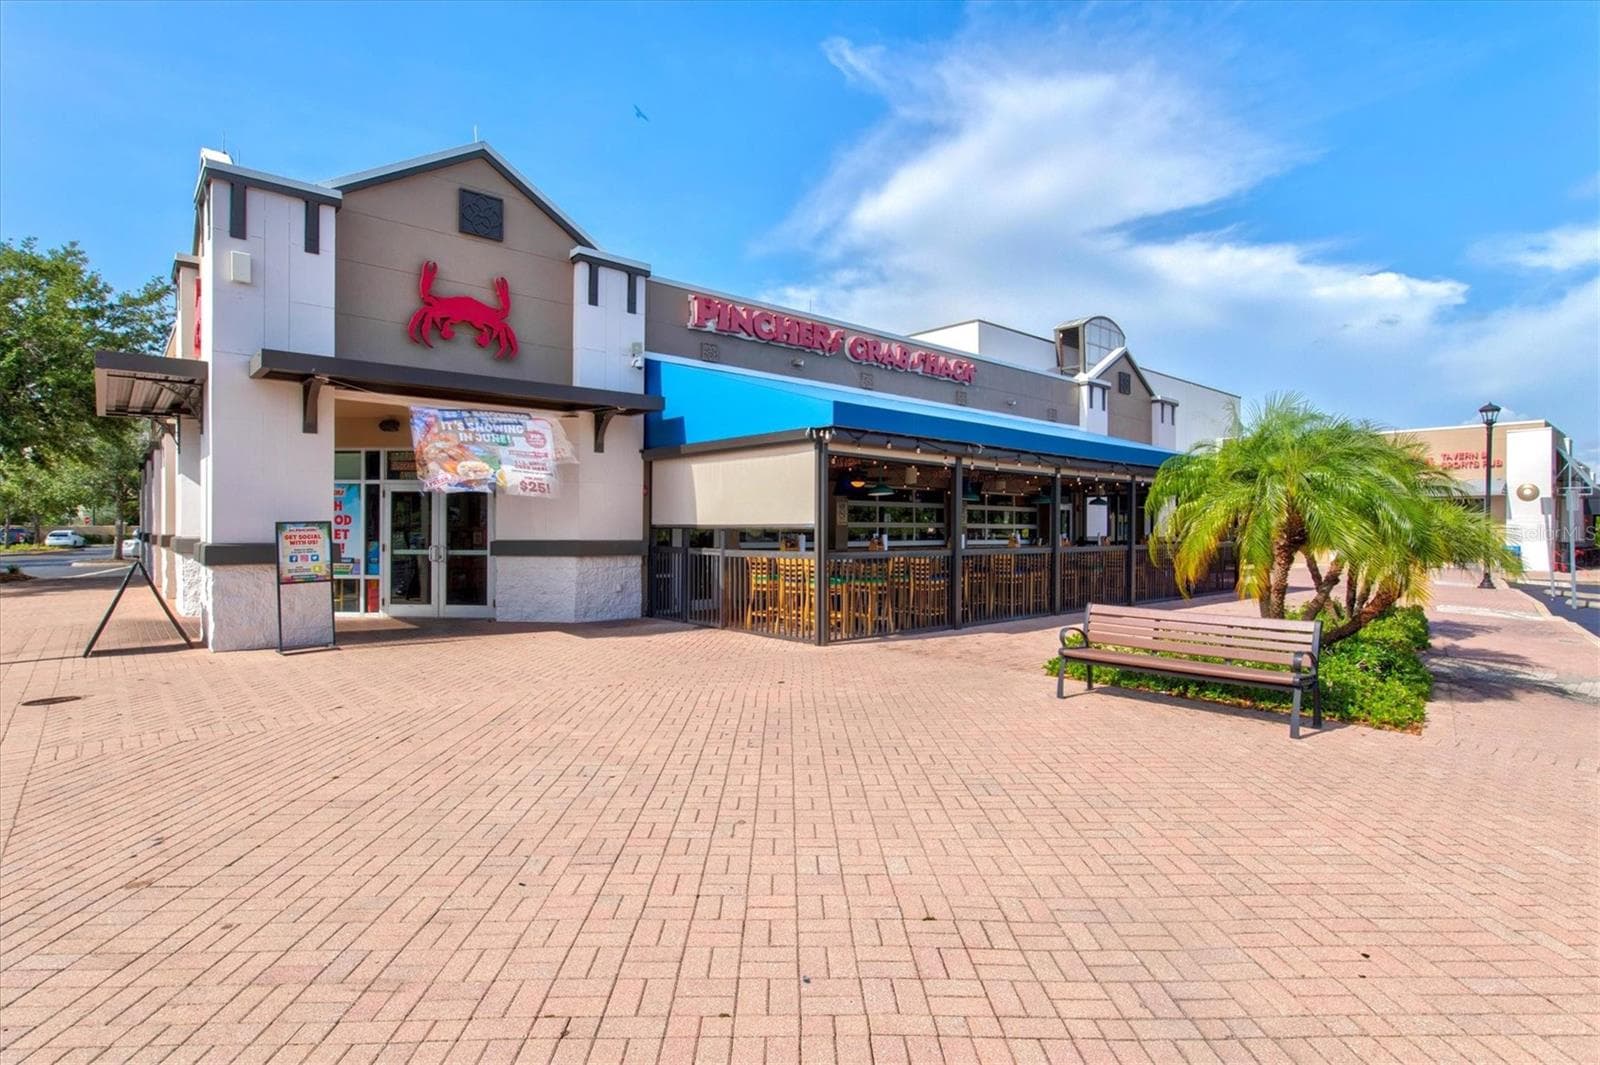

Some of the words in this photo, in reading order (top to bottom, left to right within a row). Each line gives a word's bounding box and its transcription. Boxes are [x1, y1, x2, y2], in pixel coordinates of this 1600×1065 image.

[688, 294, 844, 355] PINCHERS
[845, 336, 910, 372] CRAB
[910, 350, 976, 386] SHACK
[441, 421, 465, 431] IT'S
[468, 422, 524, 434] SNOWING
[459, 432, 473, 442] IN
[475, 434, 511, 446] JUNE!
[1441, 452, 1479, 461] TAVERN
[1440, 461, 1480, 470] SPORTS
[519, 480, 551, 494] $25!
[298, 533, 322, 541] SOCIAL
